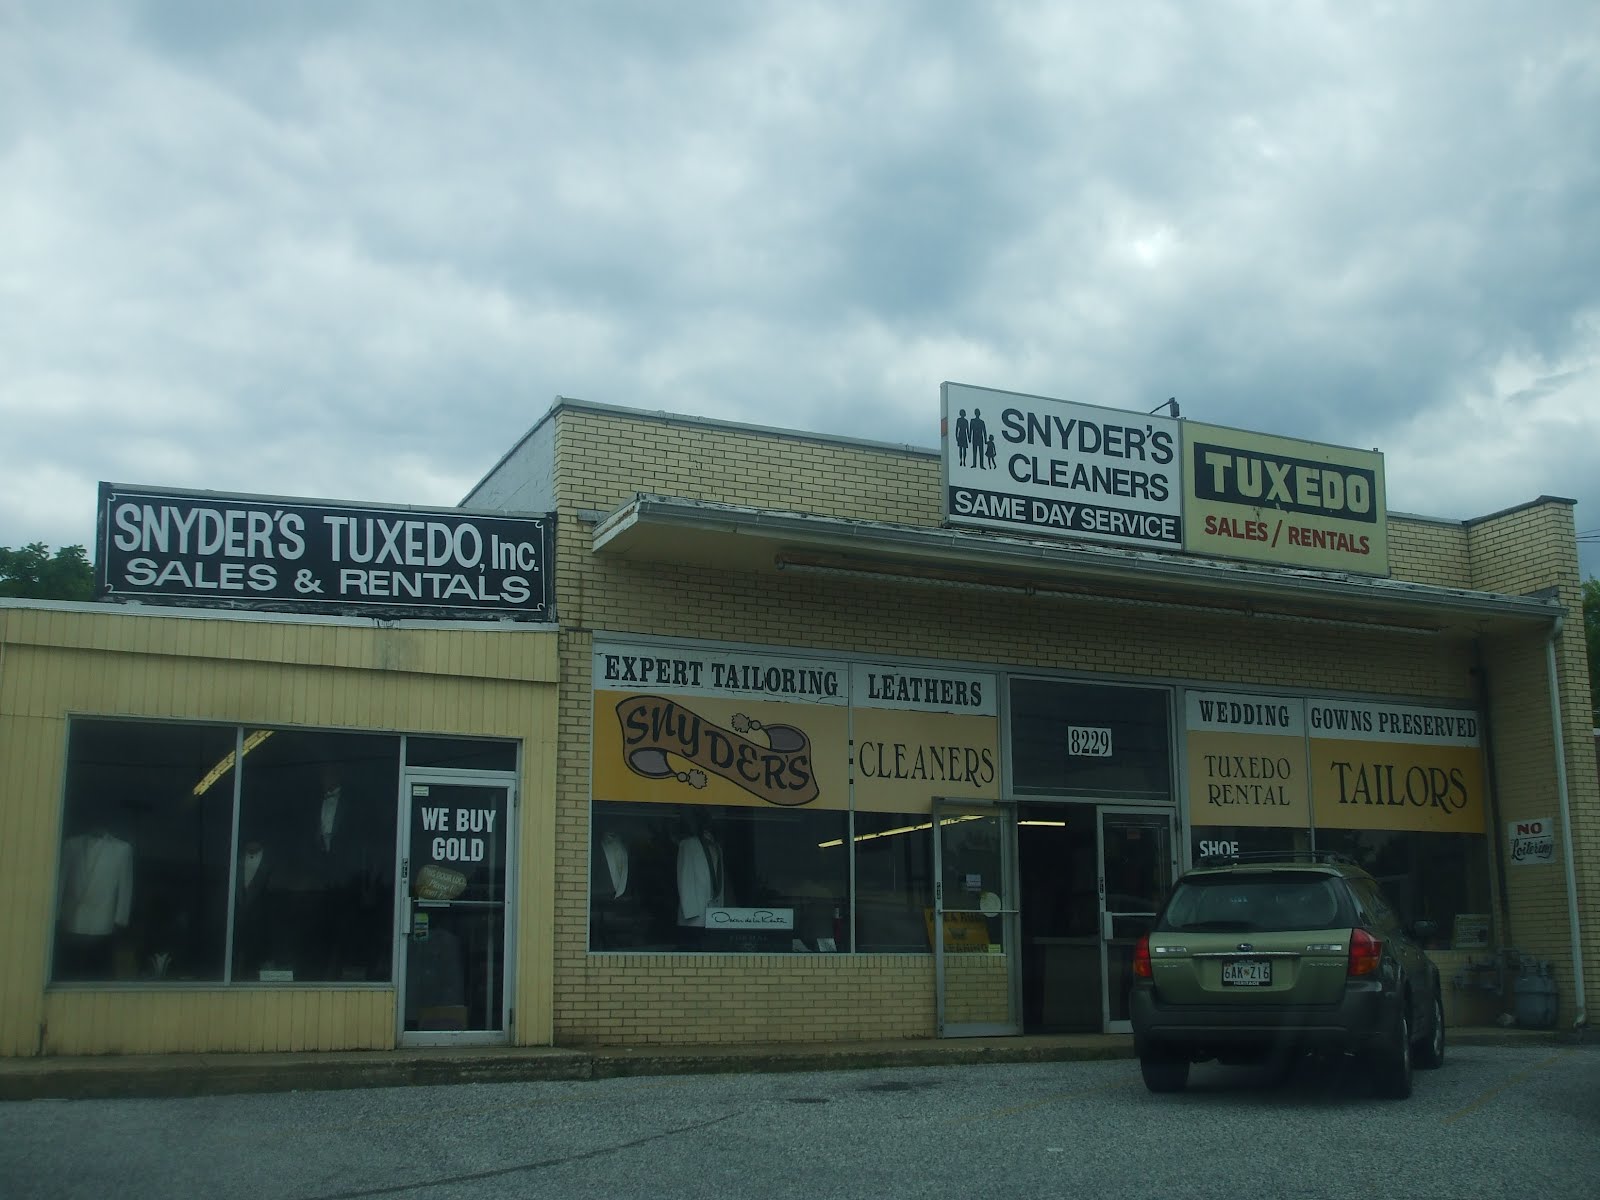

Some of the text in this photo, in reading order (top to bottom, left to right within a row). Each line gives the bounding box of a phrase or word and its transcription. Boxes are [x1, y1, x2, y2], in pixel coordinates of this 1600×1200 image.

[1001, 408, 1174, 465] SNYDER'S
[1008, 453, 1169, 502] CLEANERS
[1204, 451, 1370, 515] TUXEDO
[955, 490, 1176, 540] SAME DAY SERVICE
[114, 503, 539, 573] SNYDER'S TUXEDO, Inc.
[1288, 528, 1371, 555] RENTALS
[124, 558, 531, 603] SALES & RENTALS
[604, 654, 839, 697] EXPERT TAILORING
[868, 673, 982, 707] LEATHERS
[1200, 700, 1290, 728] WEDDING
[1310, 707, 1477, 739] GOWNS PRESERVED
[1071, 729, 1109, 755] 8229
[859, 740, 996, 788] CLEANERS
[1204, 755, 1291, 780] TUXEDO
[1208, 784, 1291, 808] RENTAL
[1330, 760, 1468, 814] TAILORS
[421, 807, 497, 833] WE BUY
[1517, 822, 1542, 835] NO
[432, 837, 484, 861] GOLD
[1199, 840, 1240, 858] SHOE
[1510, 838, 1553, 861] Loitering
